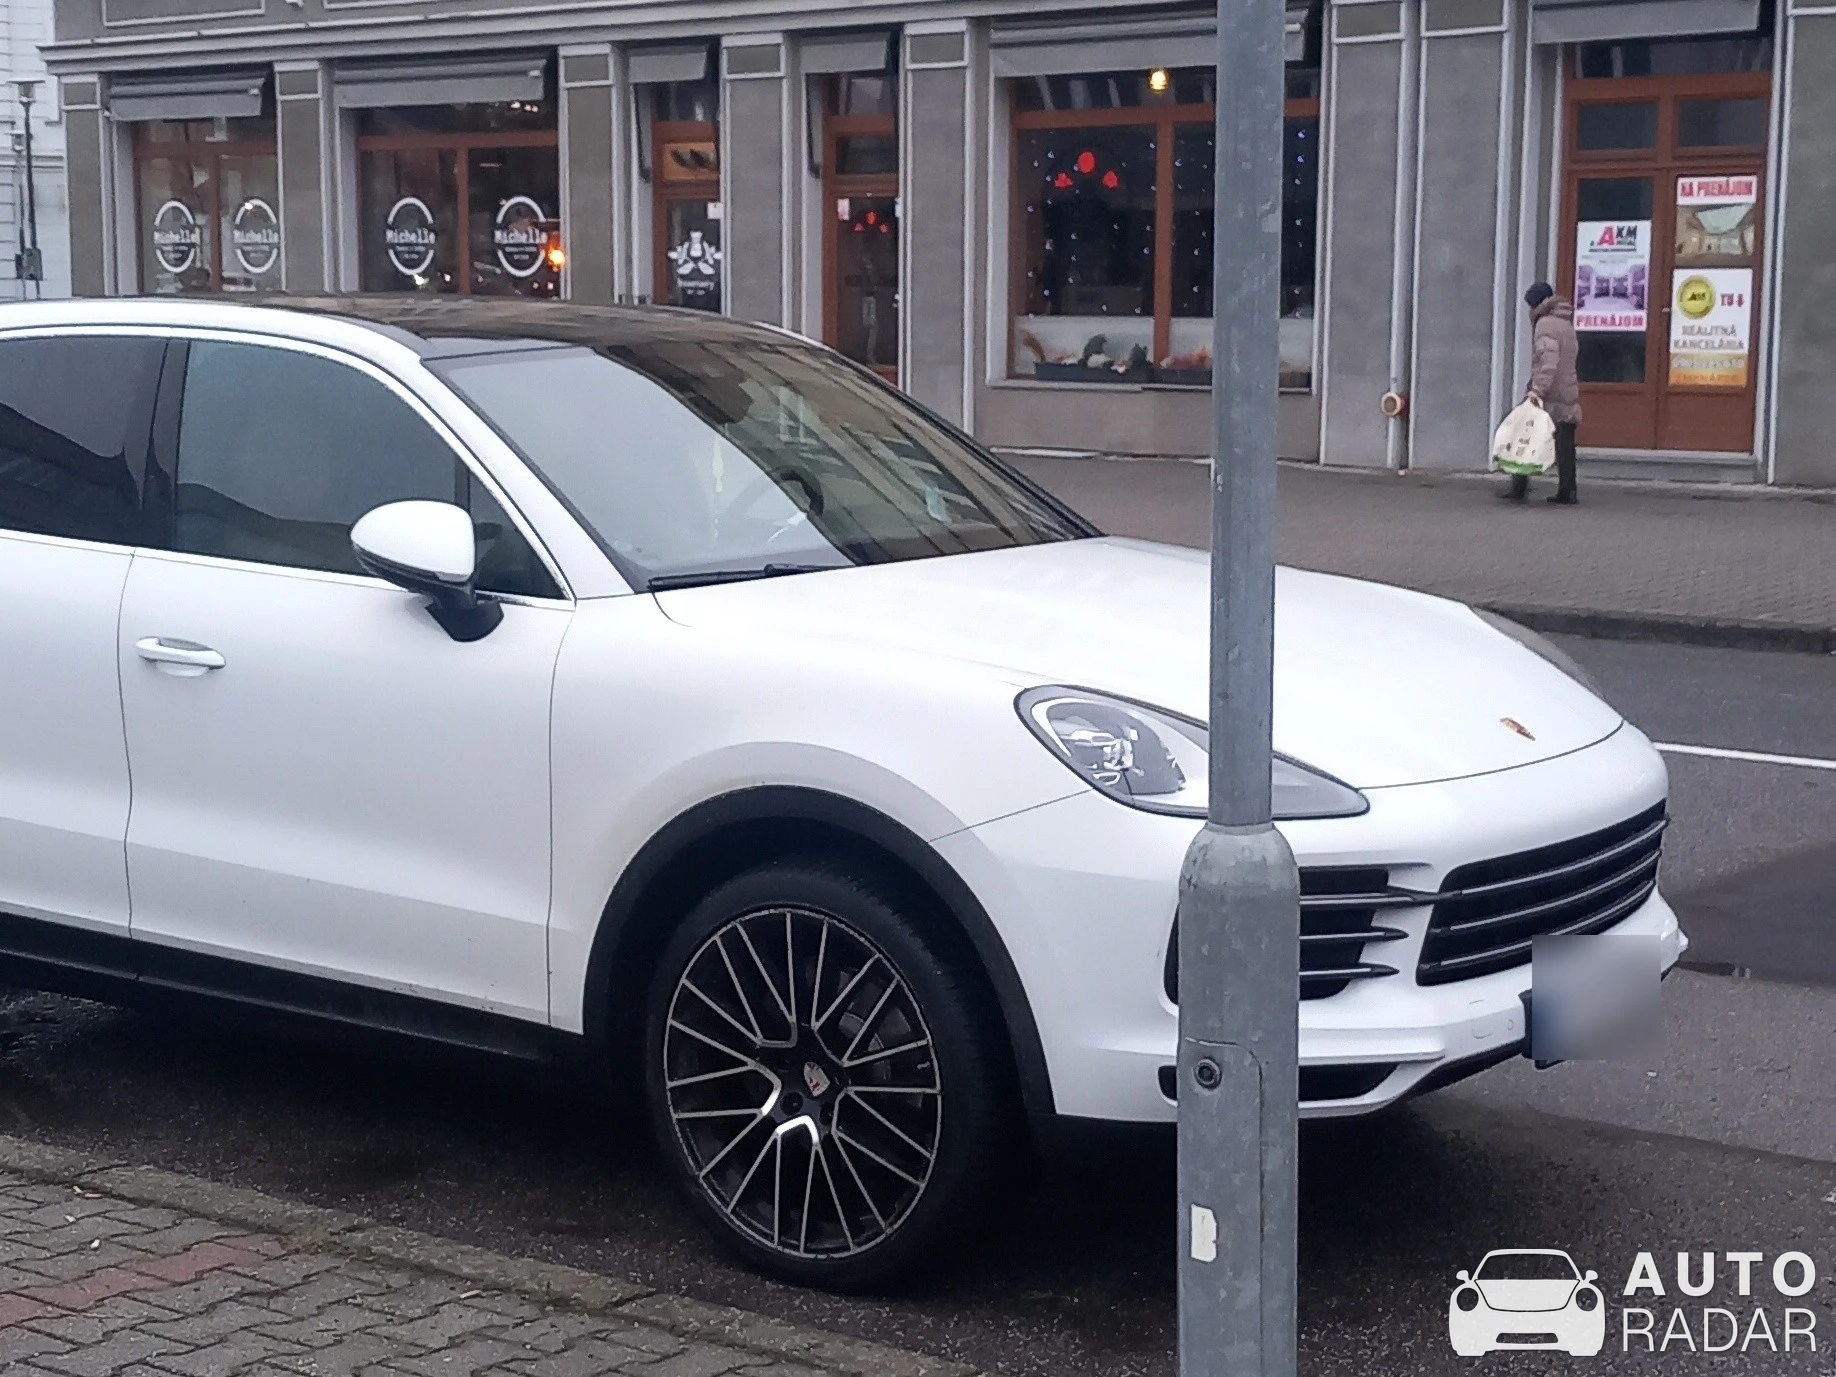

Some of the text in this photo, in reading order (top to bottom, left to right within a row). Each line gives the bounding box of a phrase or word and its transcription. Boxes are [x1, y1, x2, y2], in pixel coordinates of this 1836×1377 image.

[153, 229, 199, 243] Michelle
[233, 229, 279, 243] Michelle
[385, 227, 436, 244] Michelle
[494, 227, 548, 244] Michelle
[1597, 225, 1638, 245] AKM
[1576, 314, 1644, 327] PRENÁJOM
[1682, 324, 1738, 336] REALITNÁ
